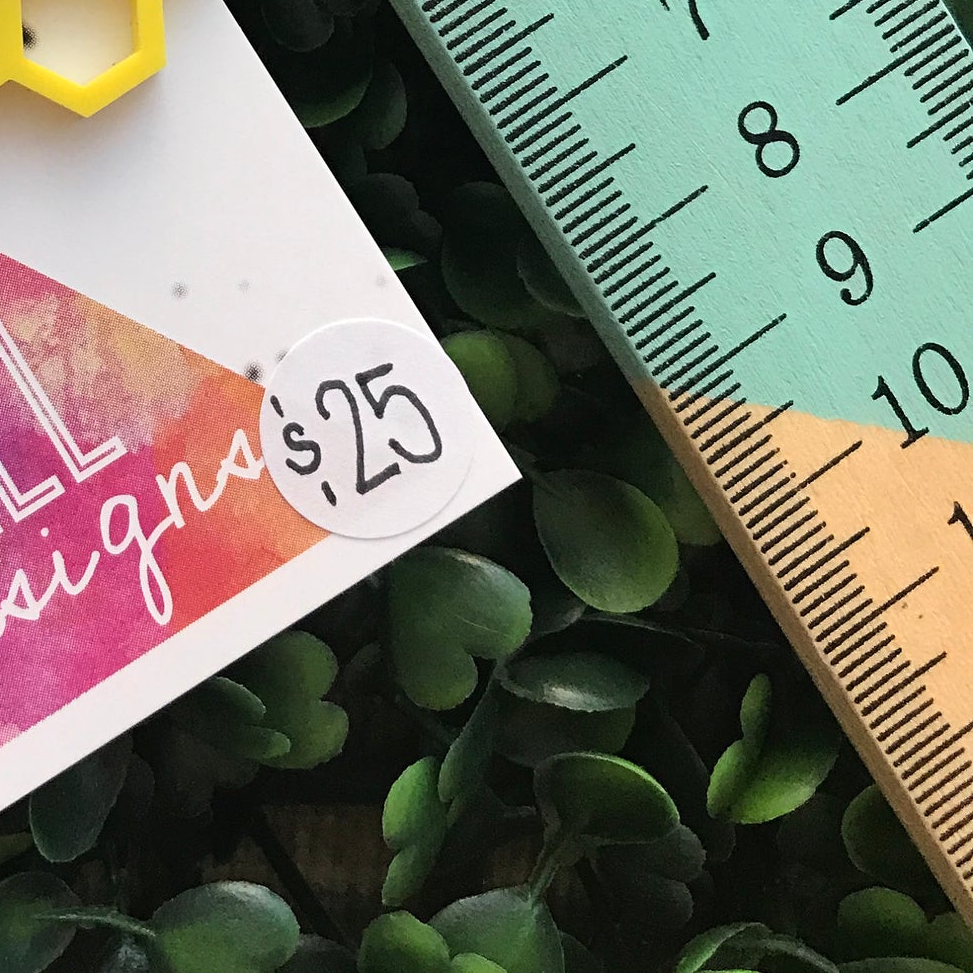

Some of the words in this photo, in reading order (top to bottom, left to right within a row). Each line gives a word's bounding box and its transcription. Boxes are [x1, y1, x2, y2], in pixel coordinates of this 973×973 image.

[738, 101, 801, 177] 8
[816, 230, 874, 305] 9
[270, 362, 443, 506] $25
[871, 342, 969, 448] 10
